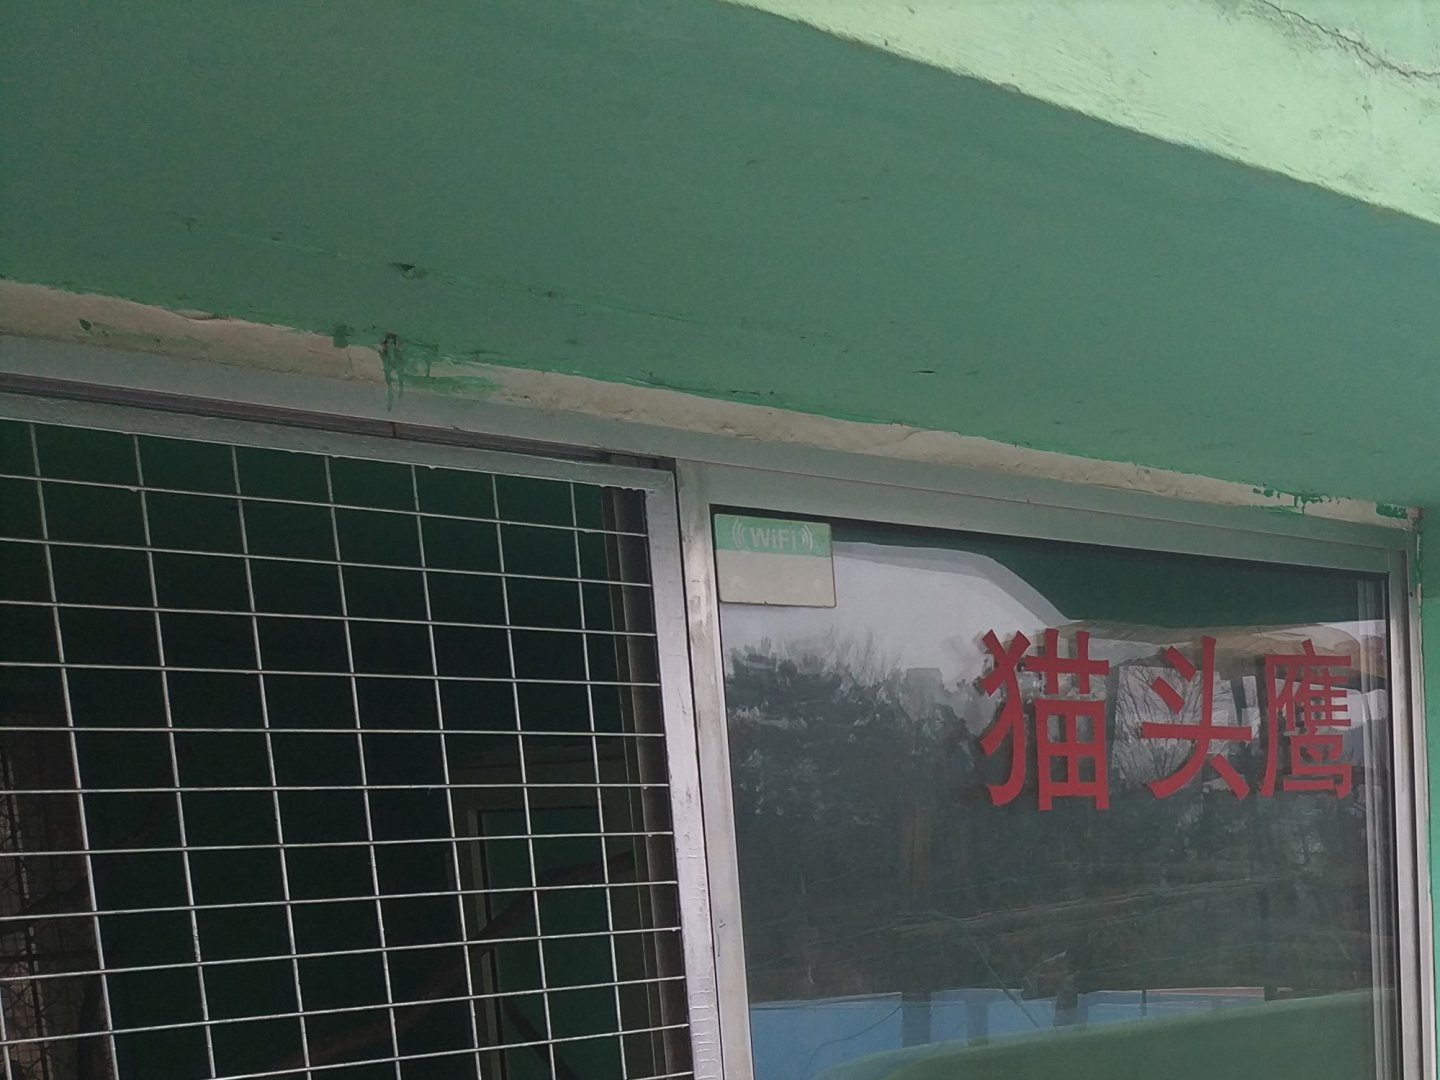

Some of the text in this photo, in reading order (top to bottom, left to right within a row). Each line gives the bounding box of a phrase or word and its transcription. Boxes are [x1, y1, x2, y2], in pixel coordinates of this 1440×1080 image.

[748, 526, 797, 550] WiFi
[979, 629, 1353, 811] 猫头鹰
